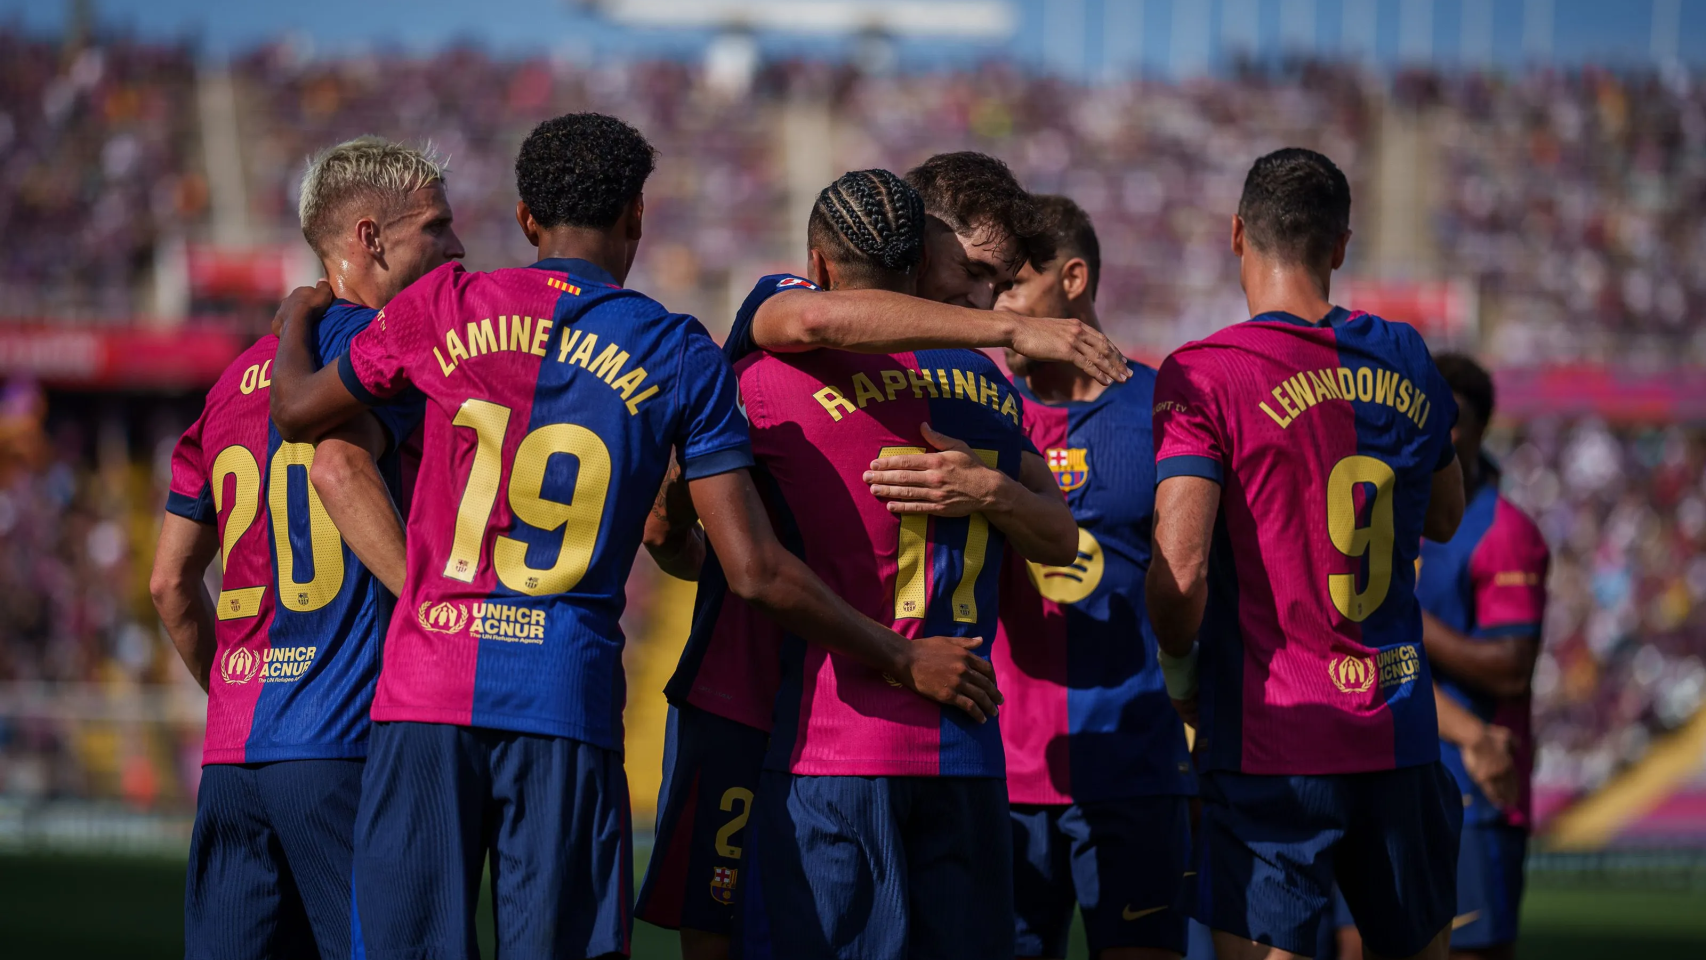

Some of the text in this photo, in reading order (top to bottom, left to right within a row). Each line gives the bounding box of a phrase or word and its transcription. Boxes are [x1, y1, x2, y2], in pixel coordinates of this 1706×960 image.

[240, 359, 272, 395] OL
[432, 315, 660, 416] LAMINE YAMAL
[812, 368, 1019, 426] RAPHINHA
[1258, 366, 1431, 429] LEWANDOWSKI
[443, 397, 612, 597] 19
[211, 439, 345, 621] 20
[878, 446, 999, 624] 11
[1326, 455, 1396, 623] 9
[469, 618, 545, 638] ACNUR
[472, 603, 546, 626] UNHCR
[259, 660, 311, 677] ACNUR
[262, 646, 316, 662] UNHCR
[1376, 645, 1418, 669] UNHCR
[1378, 658, 1420, 684] ACNUR
[714, 786, 755, 860] 2
